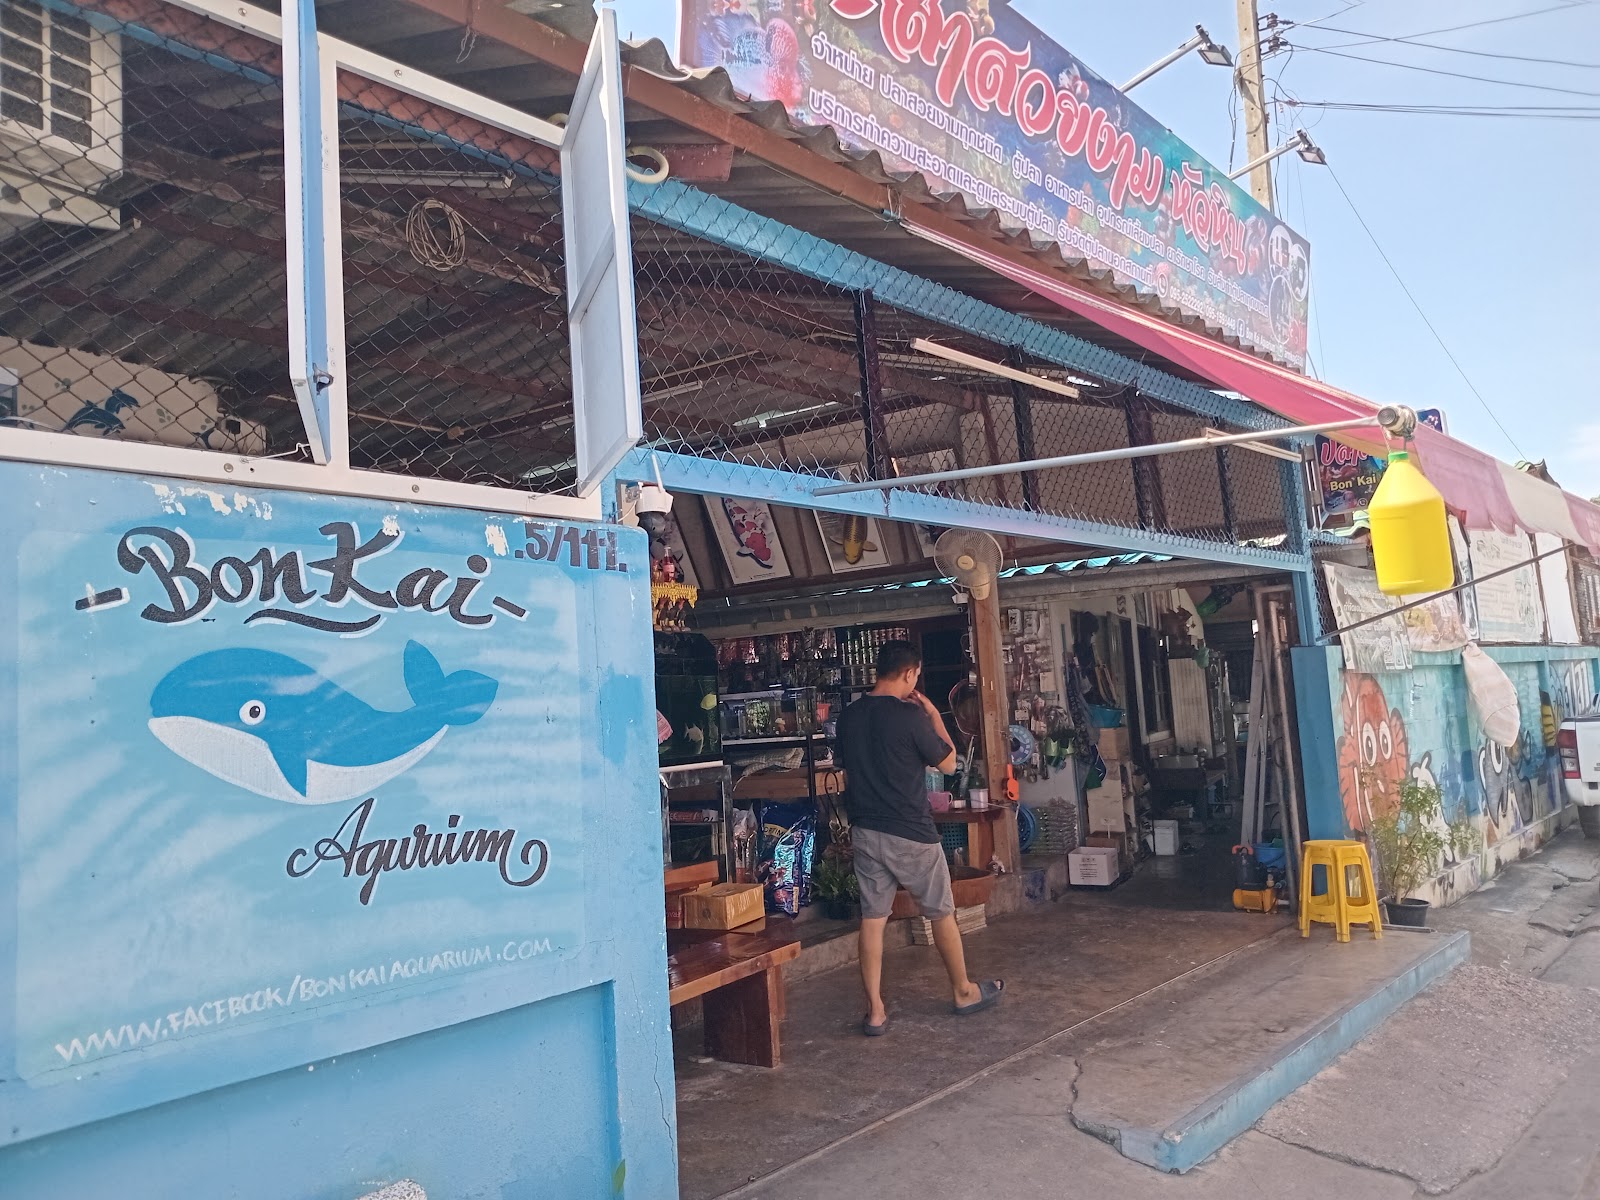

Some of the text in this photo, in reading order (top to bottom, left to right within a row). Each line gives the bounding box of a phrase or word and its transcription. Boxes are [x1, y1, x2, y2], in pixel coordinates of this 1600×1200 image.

[811, 31, 875, 90] จำหน่าย
[879, 74, 1003, 164] ปลาสวยงามทุกชนิด
[1012, 150, 1042, 187] ตู้ปลา
[1045, 174, 1095, 217] อาหารปลา
[1097, 204, 1165, 258] อุปกรณ์เลี้ยงปลา
[1167, 246, 1205, 281] ยารักษาโรค
[830, 0, 1246, 275] ลาสวยงาม หัวหิน
[1329, 474, 1377, 492] Bon Kai
